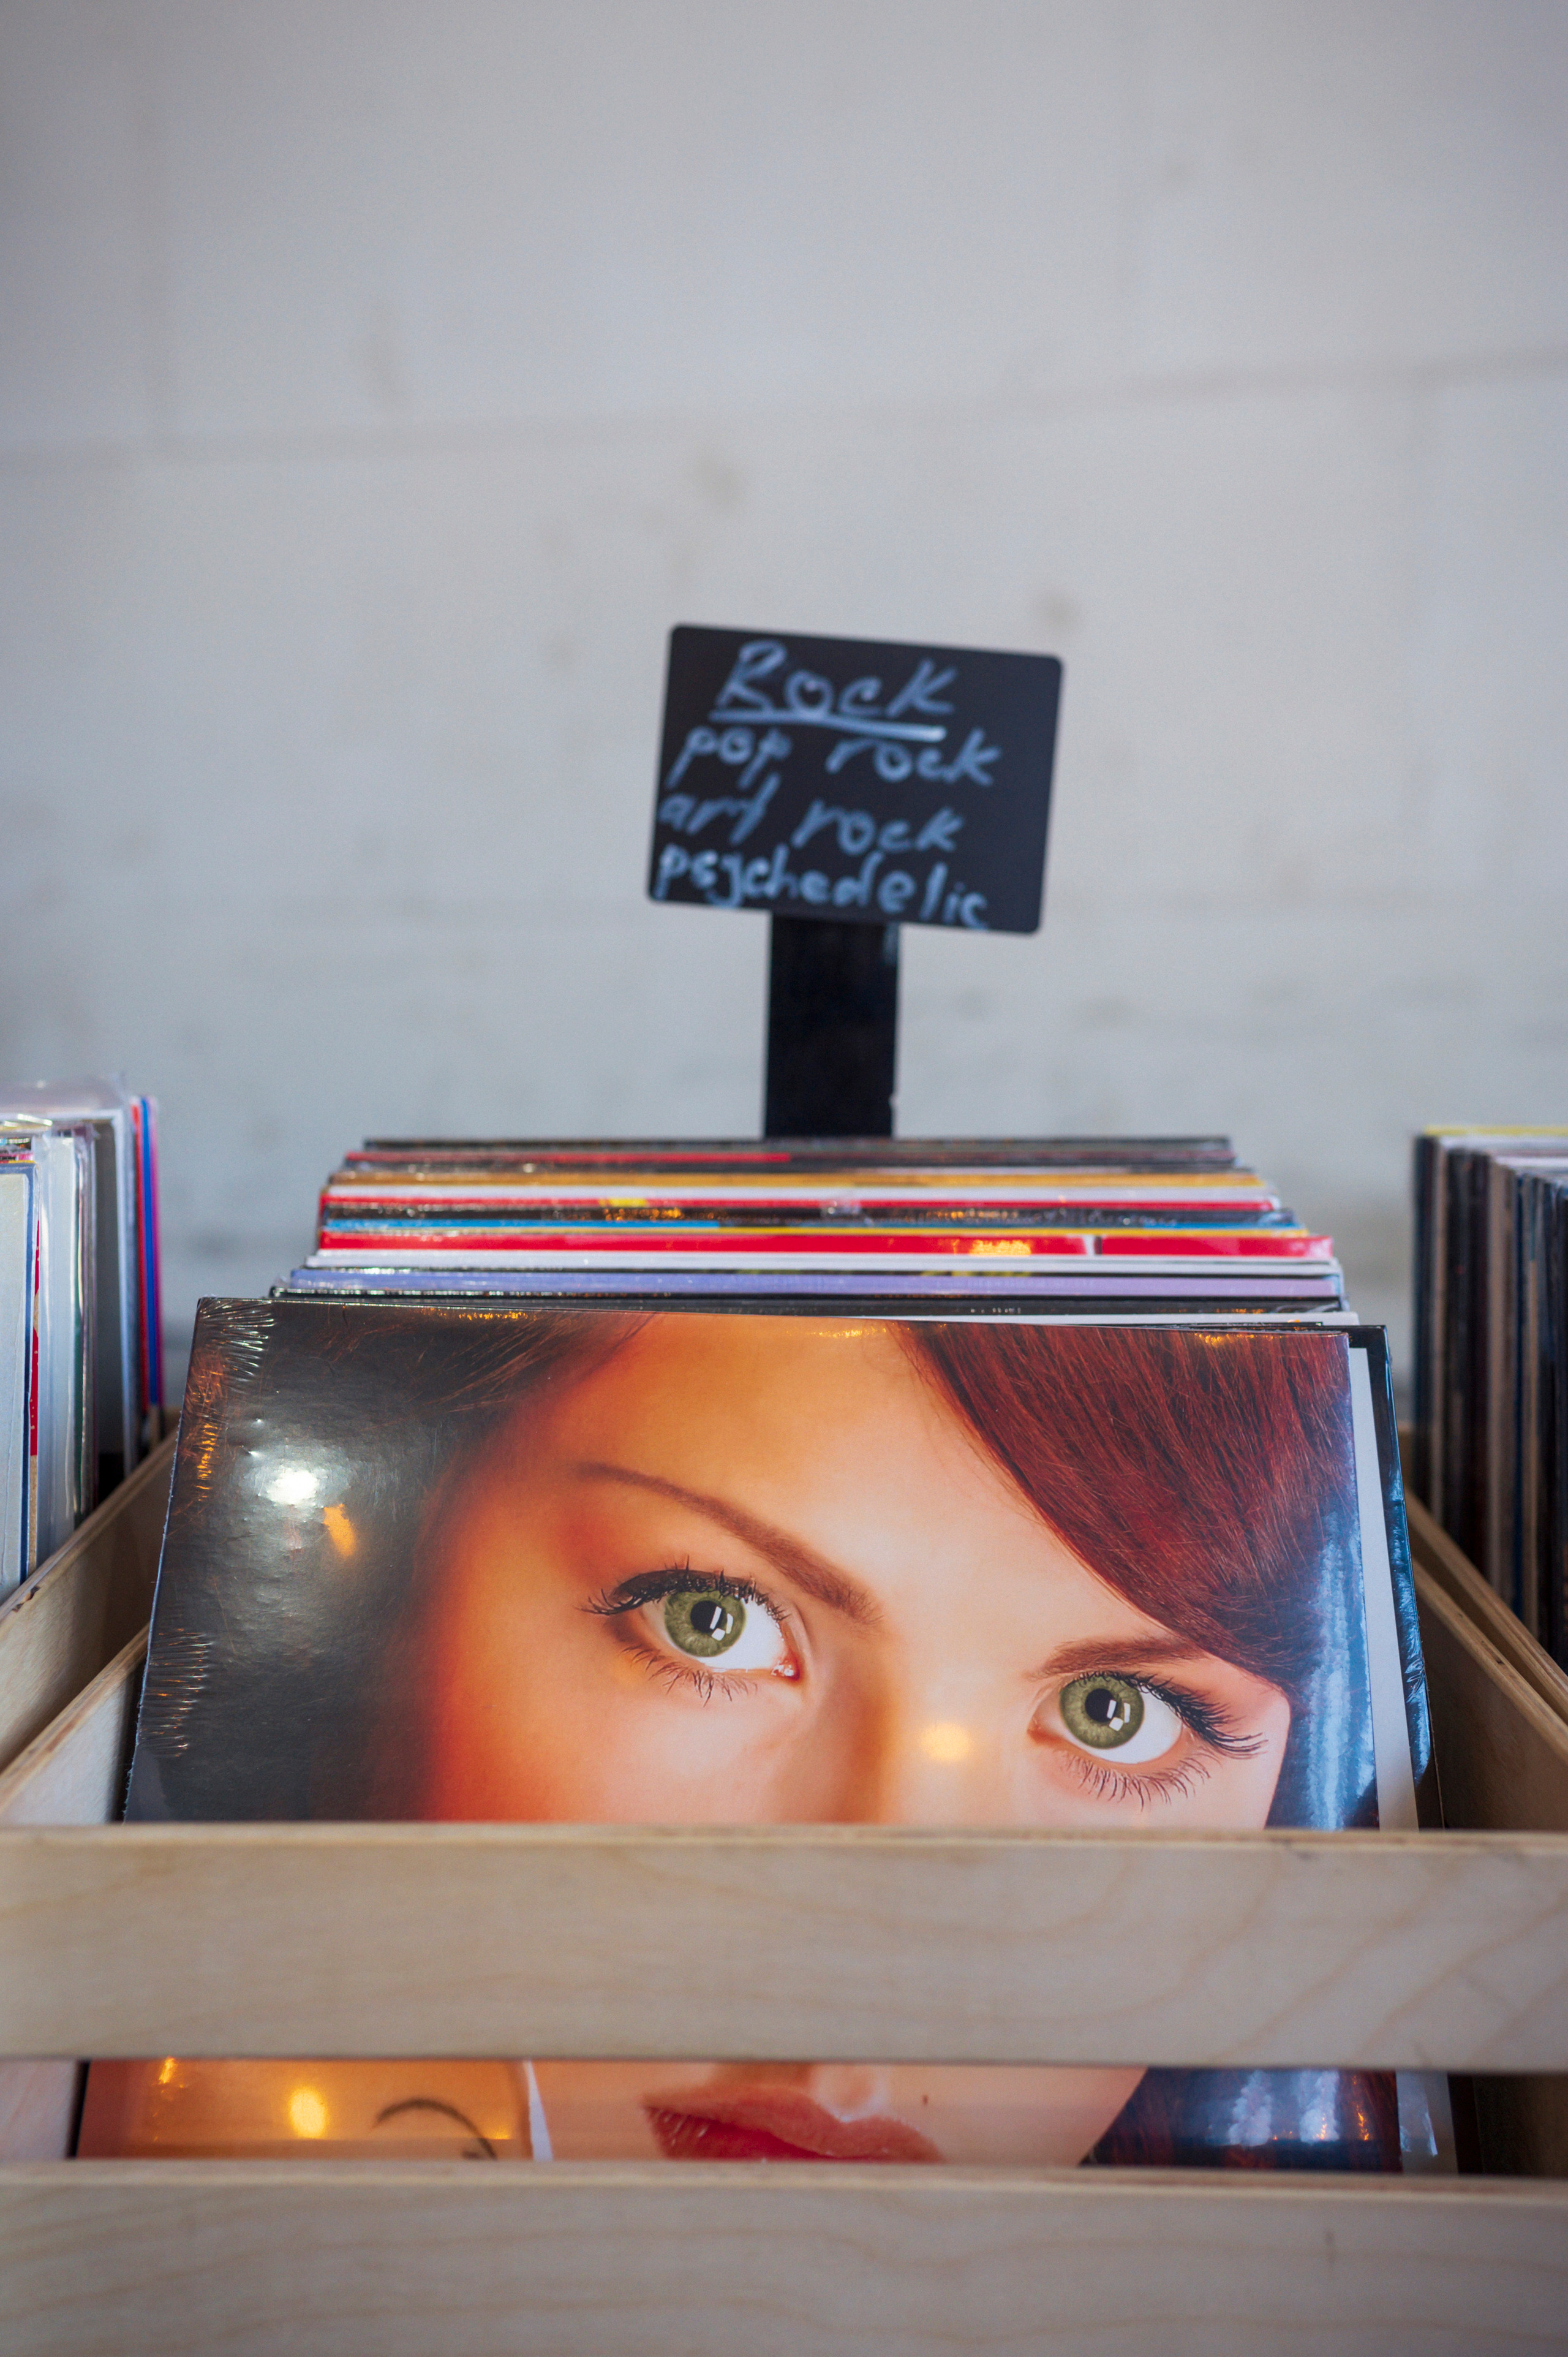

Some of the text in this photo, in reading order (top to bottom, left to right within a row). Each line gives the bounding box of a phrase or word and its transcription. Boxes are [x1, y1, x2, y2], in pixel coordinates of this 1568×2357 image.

[713, 640, 959, 719] Rock
[665, 726, 1001, 790] pop rock
[656, 772, 965, 855] art rock
[652, 843, 989, 931] psychedelic
